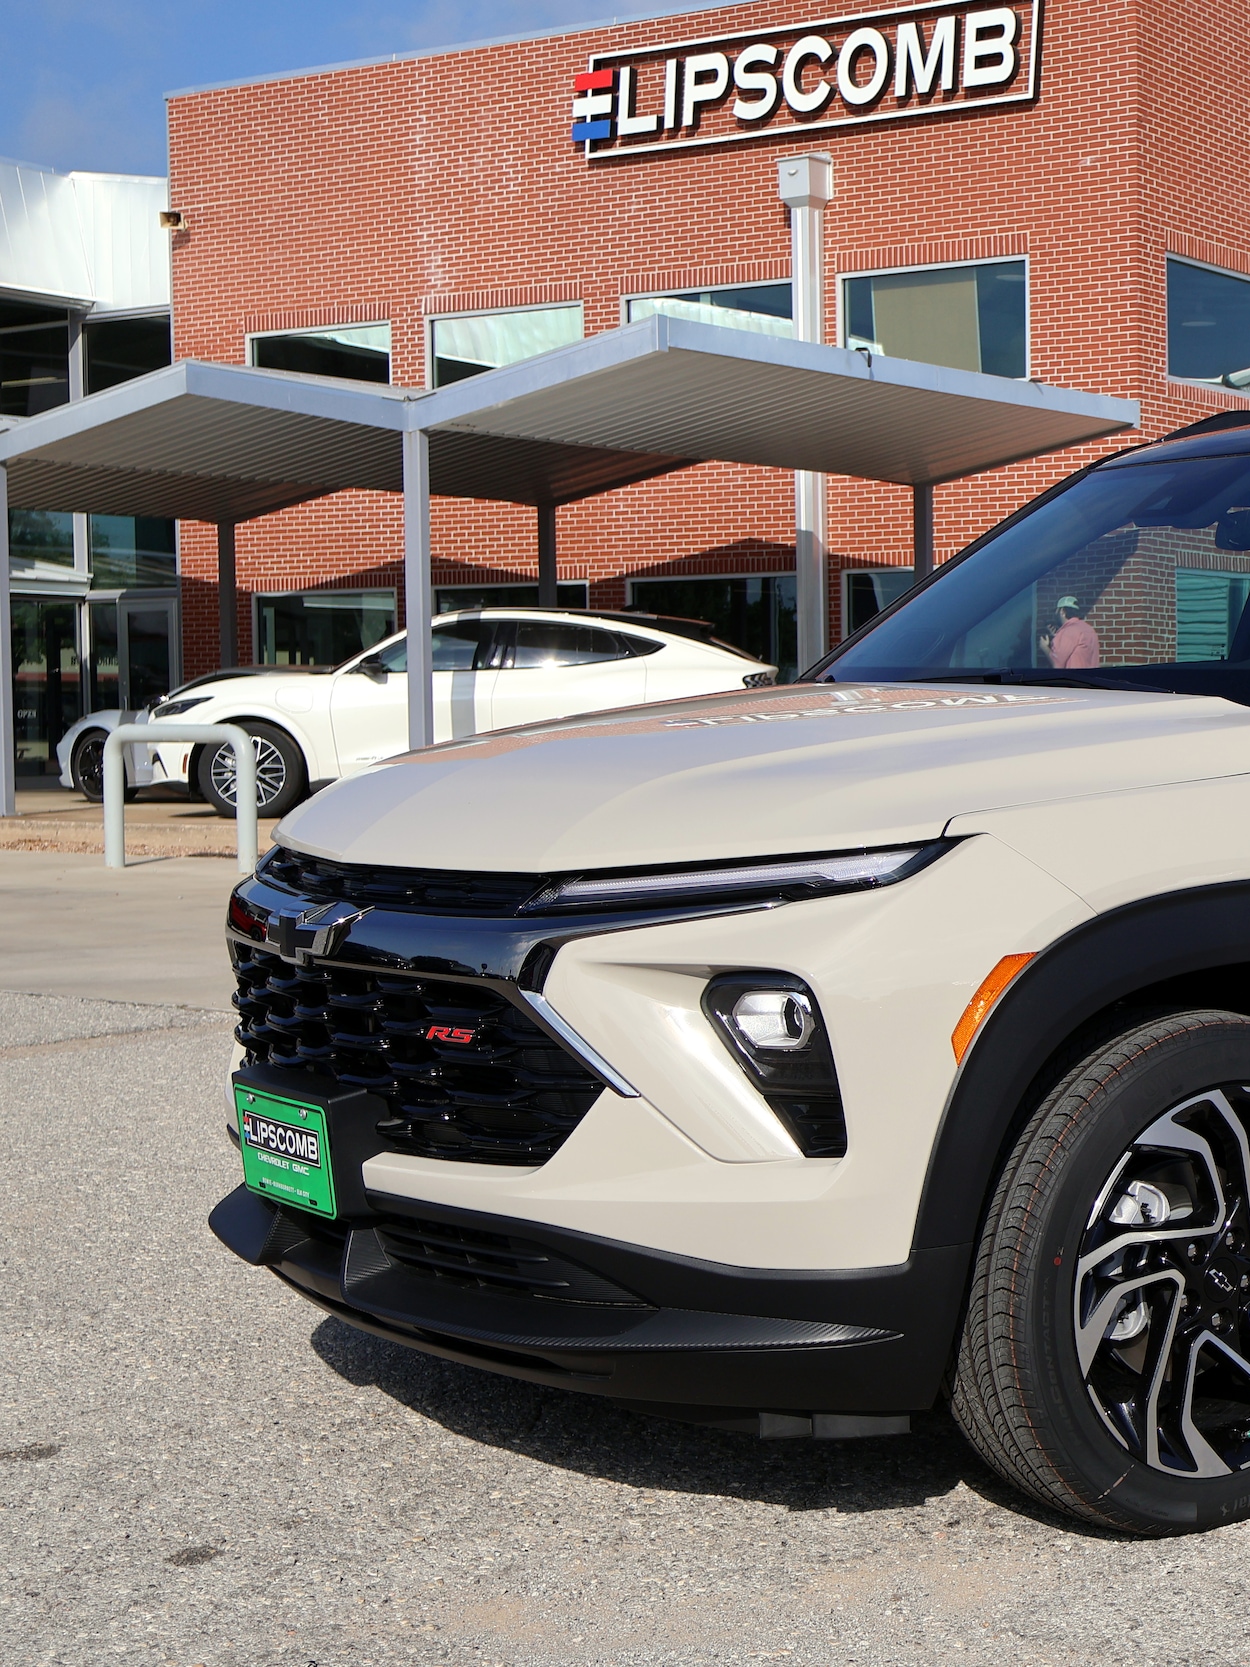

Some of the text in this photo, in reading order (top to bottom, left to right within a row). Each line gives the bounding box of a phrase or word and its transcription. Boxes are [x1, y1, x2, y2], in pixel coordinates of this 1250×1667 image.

[616, 6, 1018, 136] LIPSCOMB
[426, 1026, 475, 1043] RS
[249, 1118, 318, 1160] LIPSCOMB
[257, 1152, 310, 1176] CHEVROLET GMC
